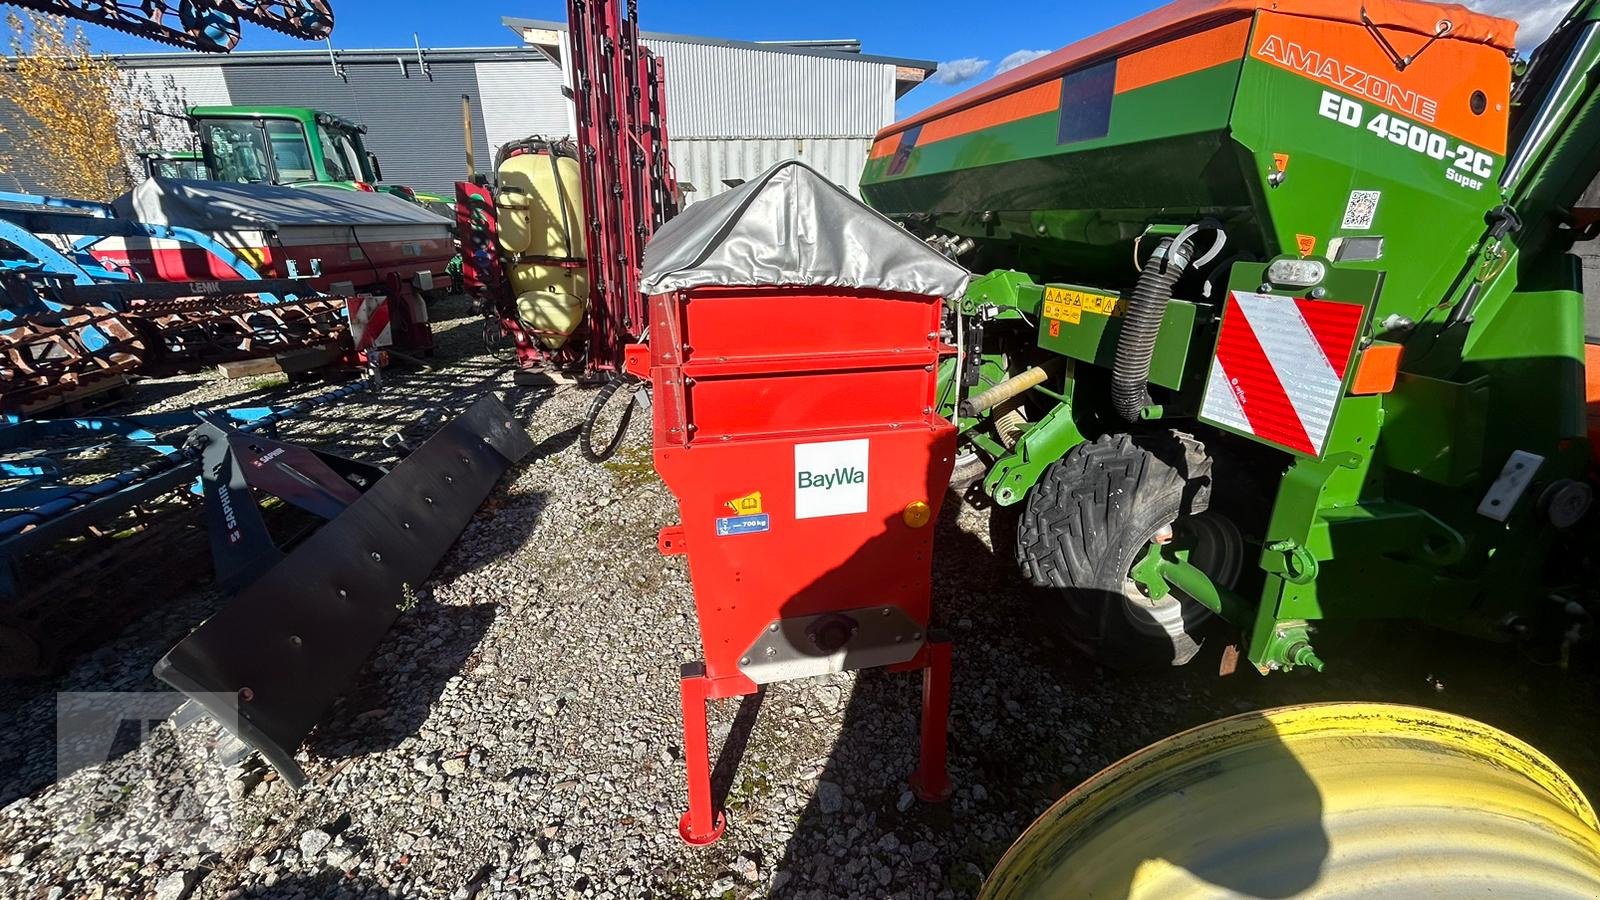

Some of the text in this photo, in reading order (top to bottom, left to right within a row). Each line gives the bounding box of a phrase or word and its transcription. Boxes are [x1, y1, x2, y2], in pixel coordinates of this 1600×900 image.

[1259, 35, 1437, 122] AMAZONE
[1319, 91, 1493, 179] ED 4500-2C
[1445, 167, 1483, 190] Super
[798, 467, 864, 489] BayWa
[218, 484, 237, 530] SAPHIR
